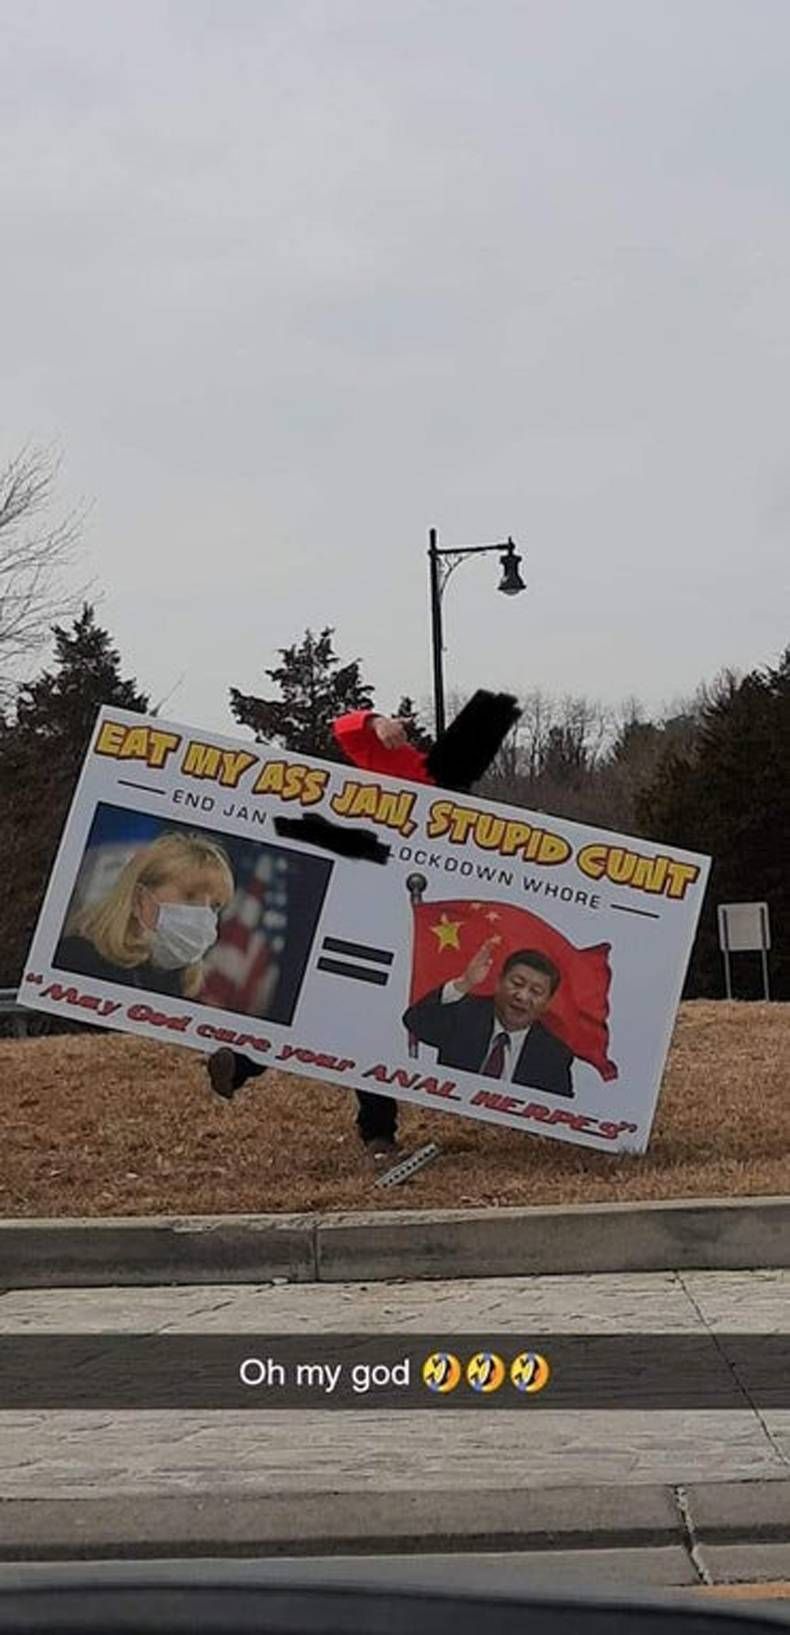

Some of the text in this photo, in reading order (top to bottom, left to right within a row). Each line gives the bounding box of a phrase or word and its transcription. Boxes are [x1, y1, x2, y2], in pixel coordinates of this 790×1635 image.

[95, 721, 700, 900] EAT MY ASS JAN, STUPID CUNT
[172, 789, 215, 811] END
[223, 803, 267, 825] JAN
[523, 877, 602, 910] WHORE
[126, 1003, 193, 1032] God
[197, 1023, 271, 1053] cure
[275, 1044, 355, 1073] your
[361, 1064, 462, 1101] ANAL
